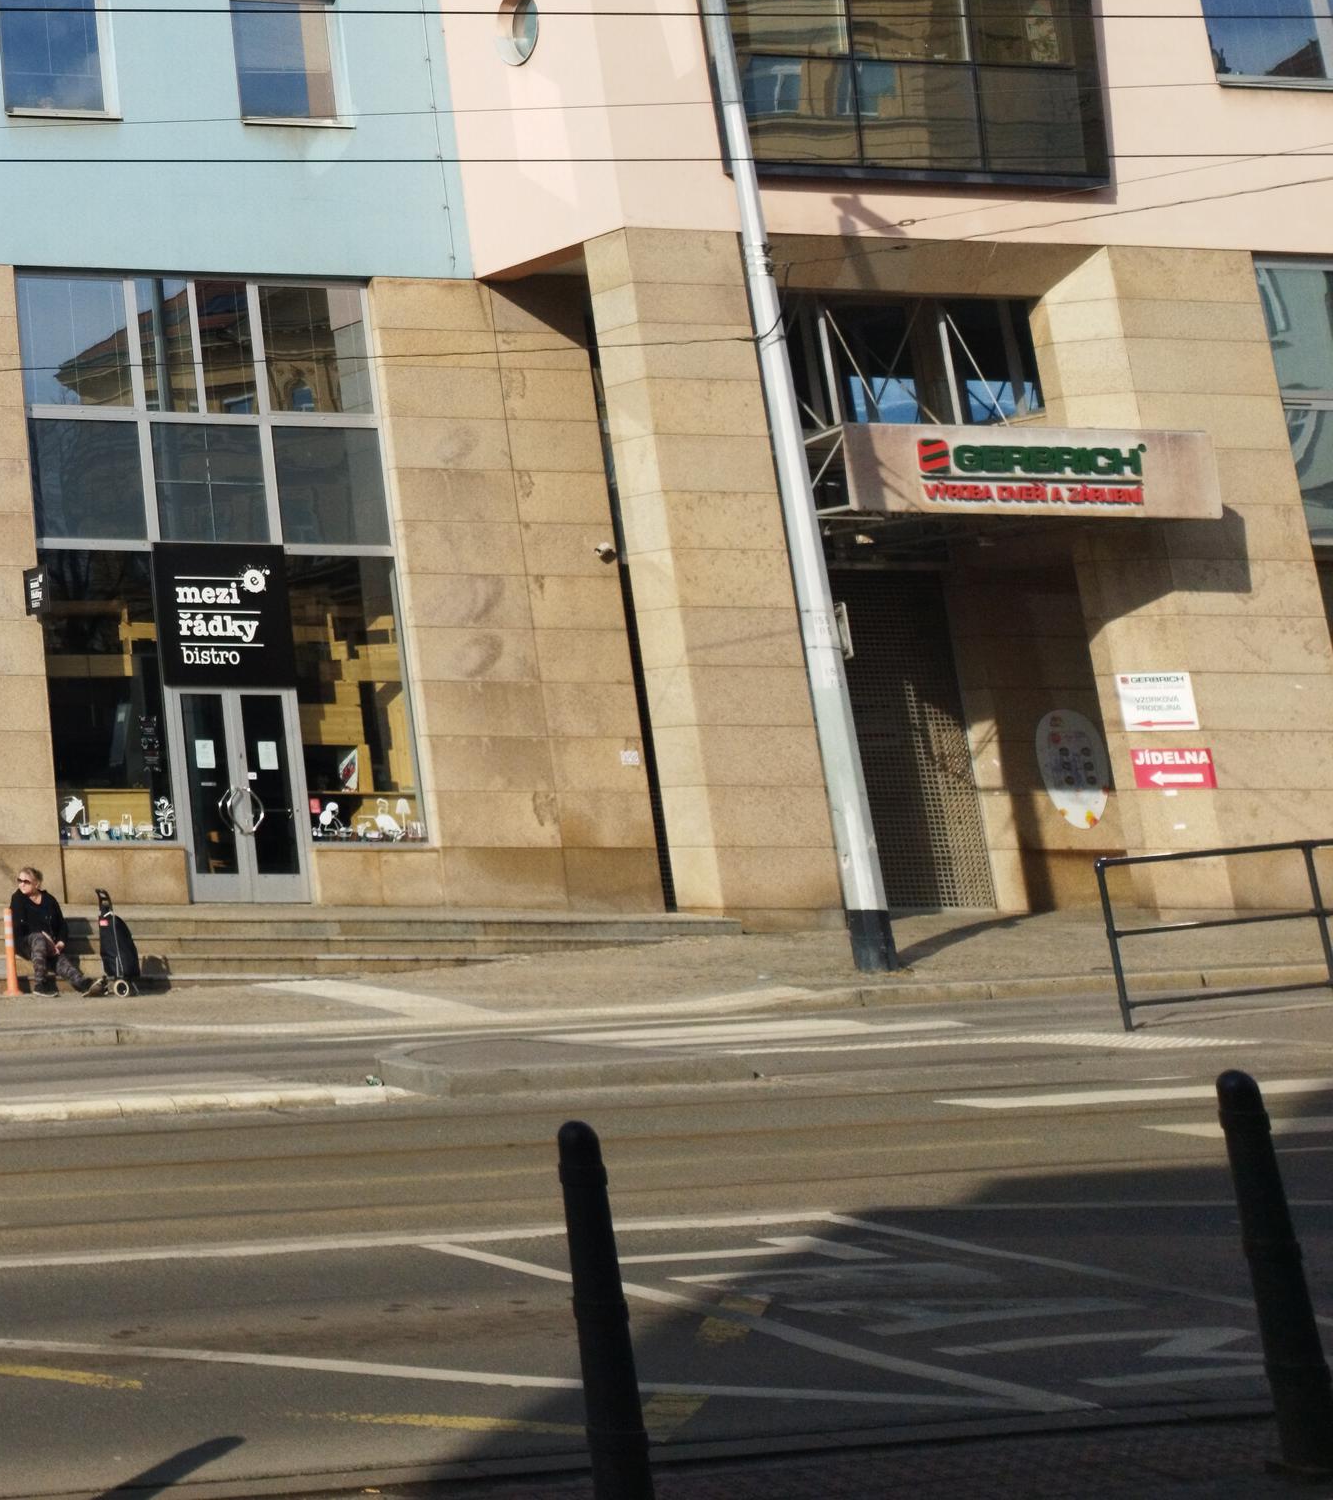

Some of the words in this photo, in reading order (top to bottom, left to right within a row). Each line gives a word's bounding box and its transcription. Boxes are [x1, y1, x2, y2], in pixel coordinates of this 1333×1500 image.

[953, 445, 1143, 476] GERBRICH
[923, 479, 993, 501] VÝROBA
[1051, 486, 1064, 503] A
[1066, 483, 1144, 505] ZÁRUBNÍ
[175, 582, 240, 604] mezi
[178, 612, 260, 642] řádky
[180, 647, 240, 665] bistro
[1135, 749, 1211, 765] JÍDELNA
